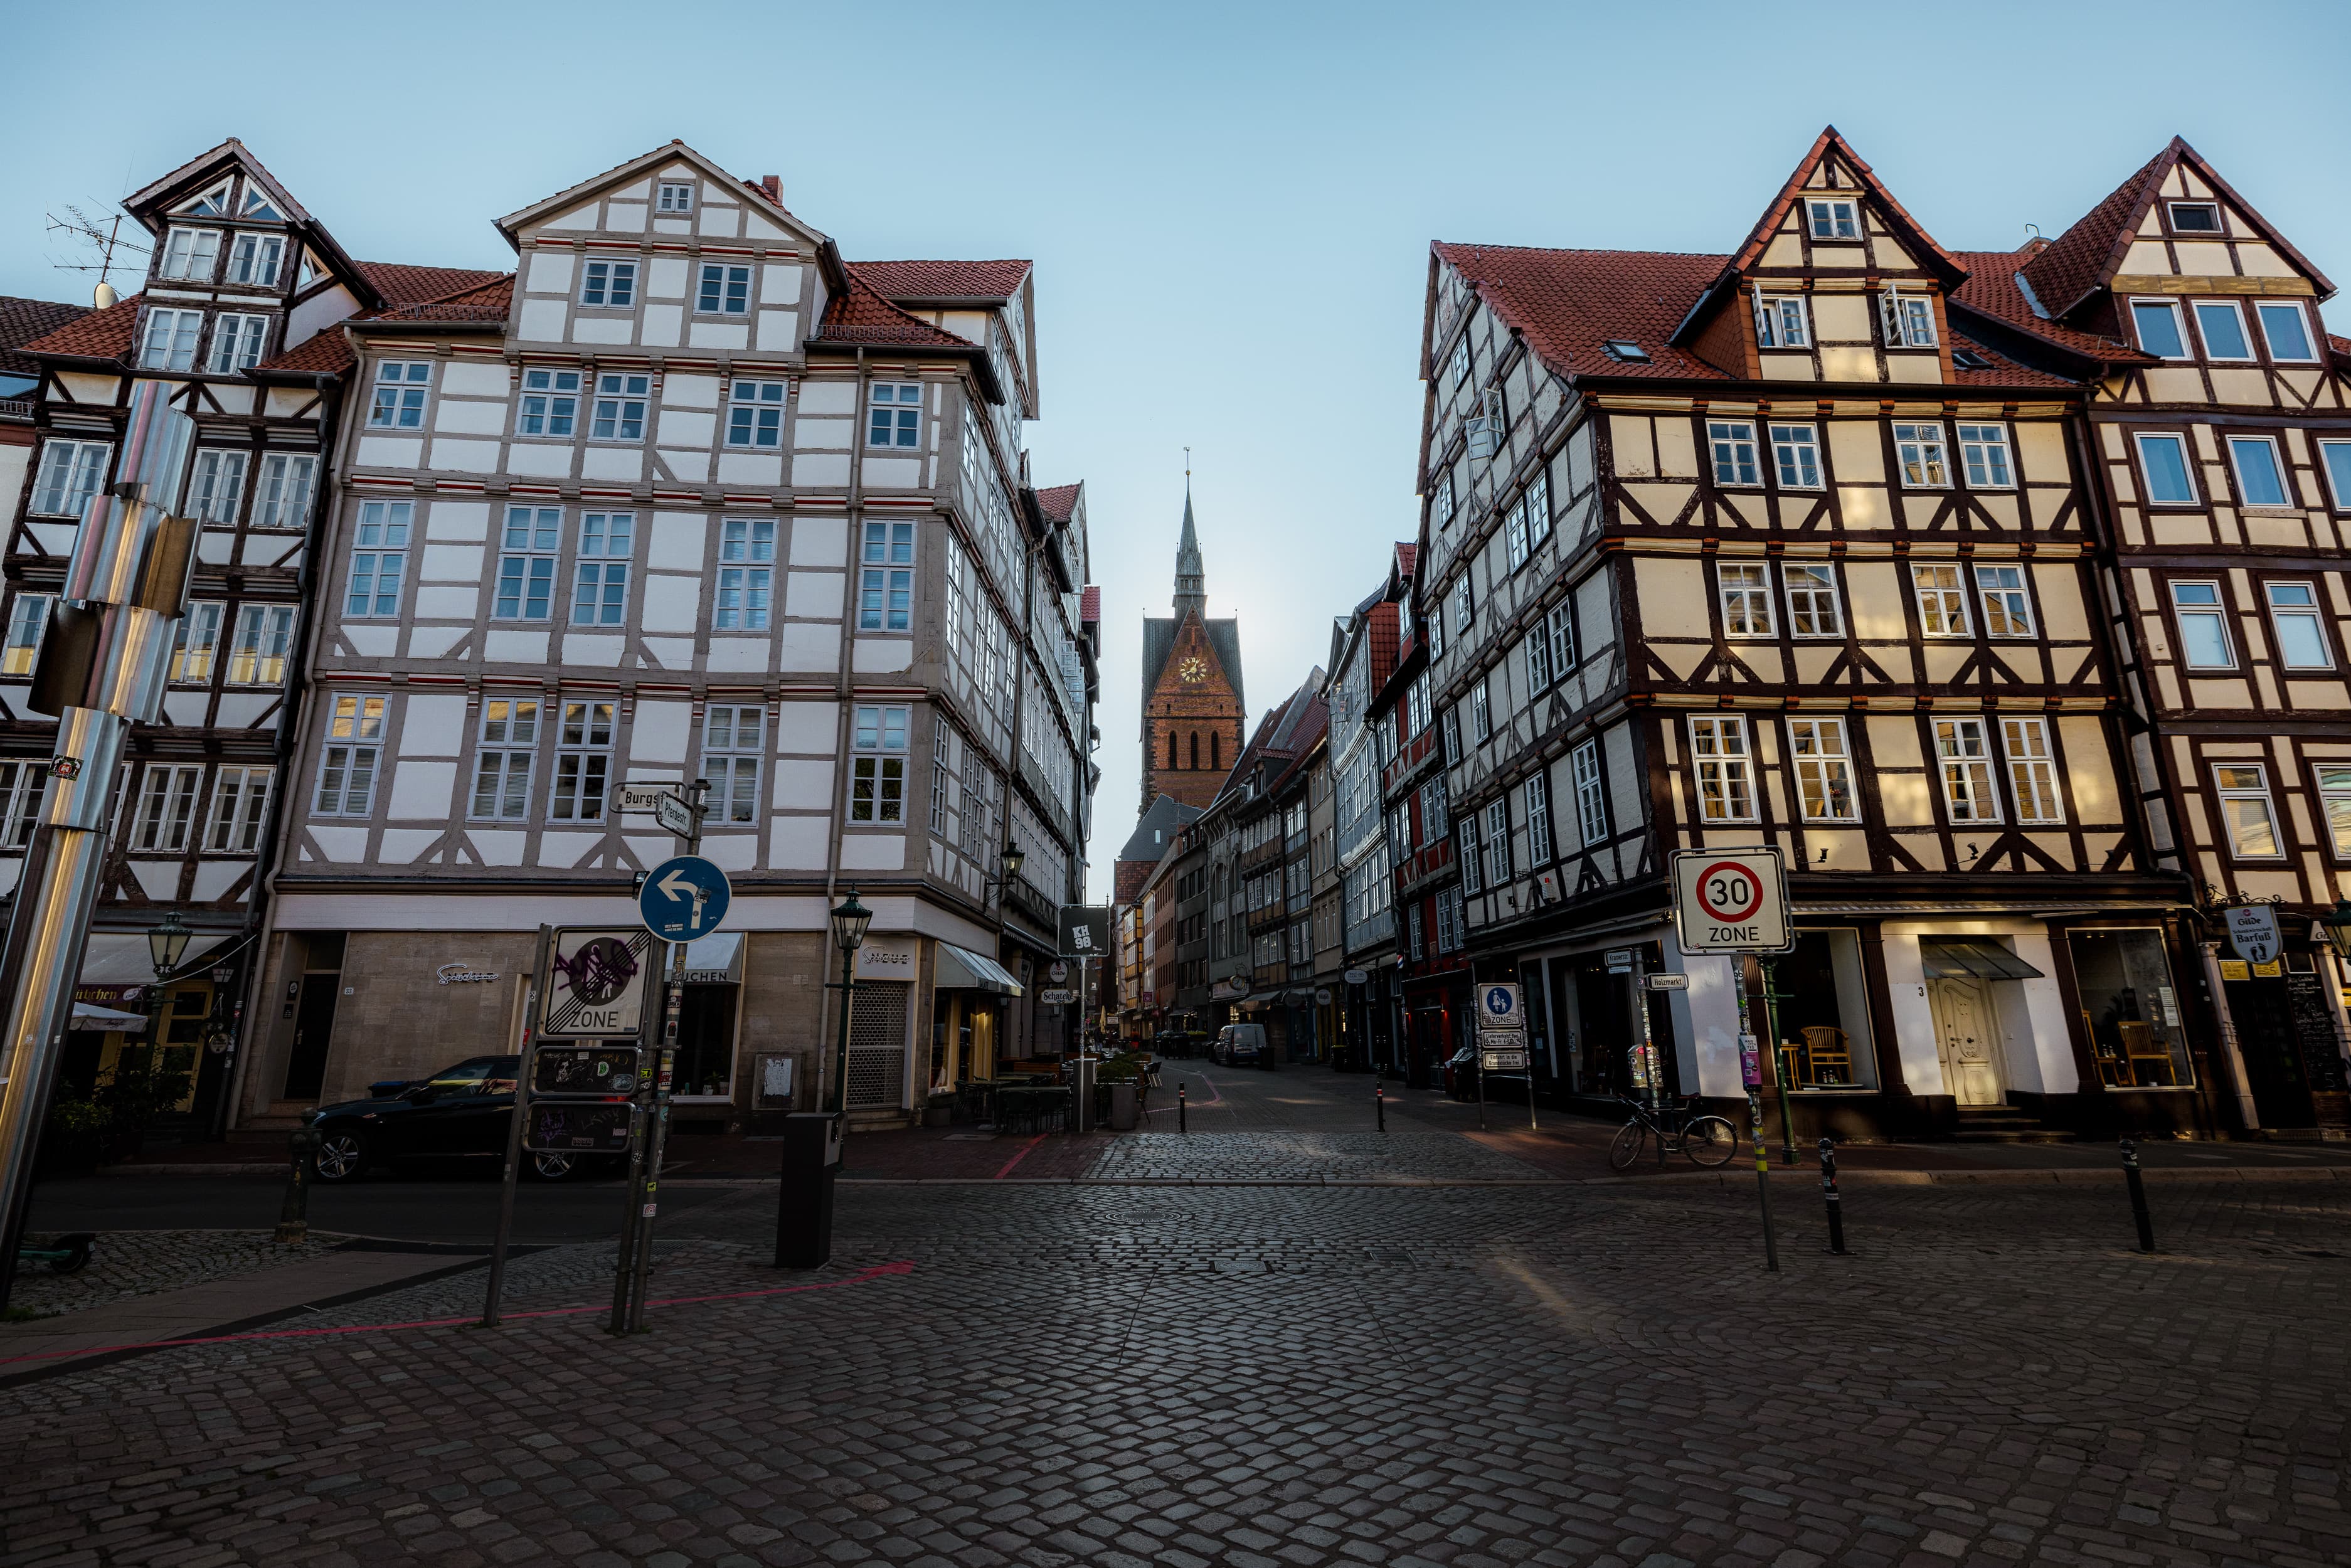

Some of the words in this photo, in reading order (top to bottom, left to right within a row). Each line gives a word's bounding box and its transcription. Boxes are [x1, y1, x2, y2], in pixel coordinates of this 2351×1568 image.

[665, 802, 687, 827] Pferdestr.
[1710, 878, 1749, 906] 30
[2238, 918, 2261, 926] Gilde
[1072, 924, 1090, 938] KH
[1709, 927, 1759, 942] ZONE
[2236, 932, 2271, 943] Barfuß
[1075, 936, 1092, 950] 98
[437, 963, 499, 985] Speisekammer
[1654, 978, 1682, 986] Holzmarkt
[1918, 987, 1924, 997] 3
[570, 1012, 618, 1027] ZONE
